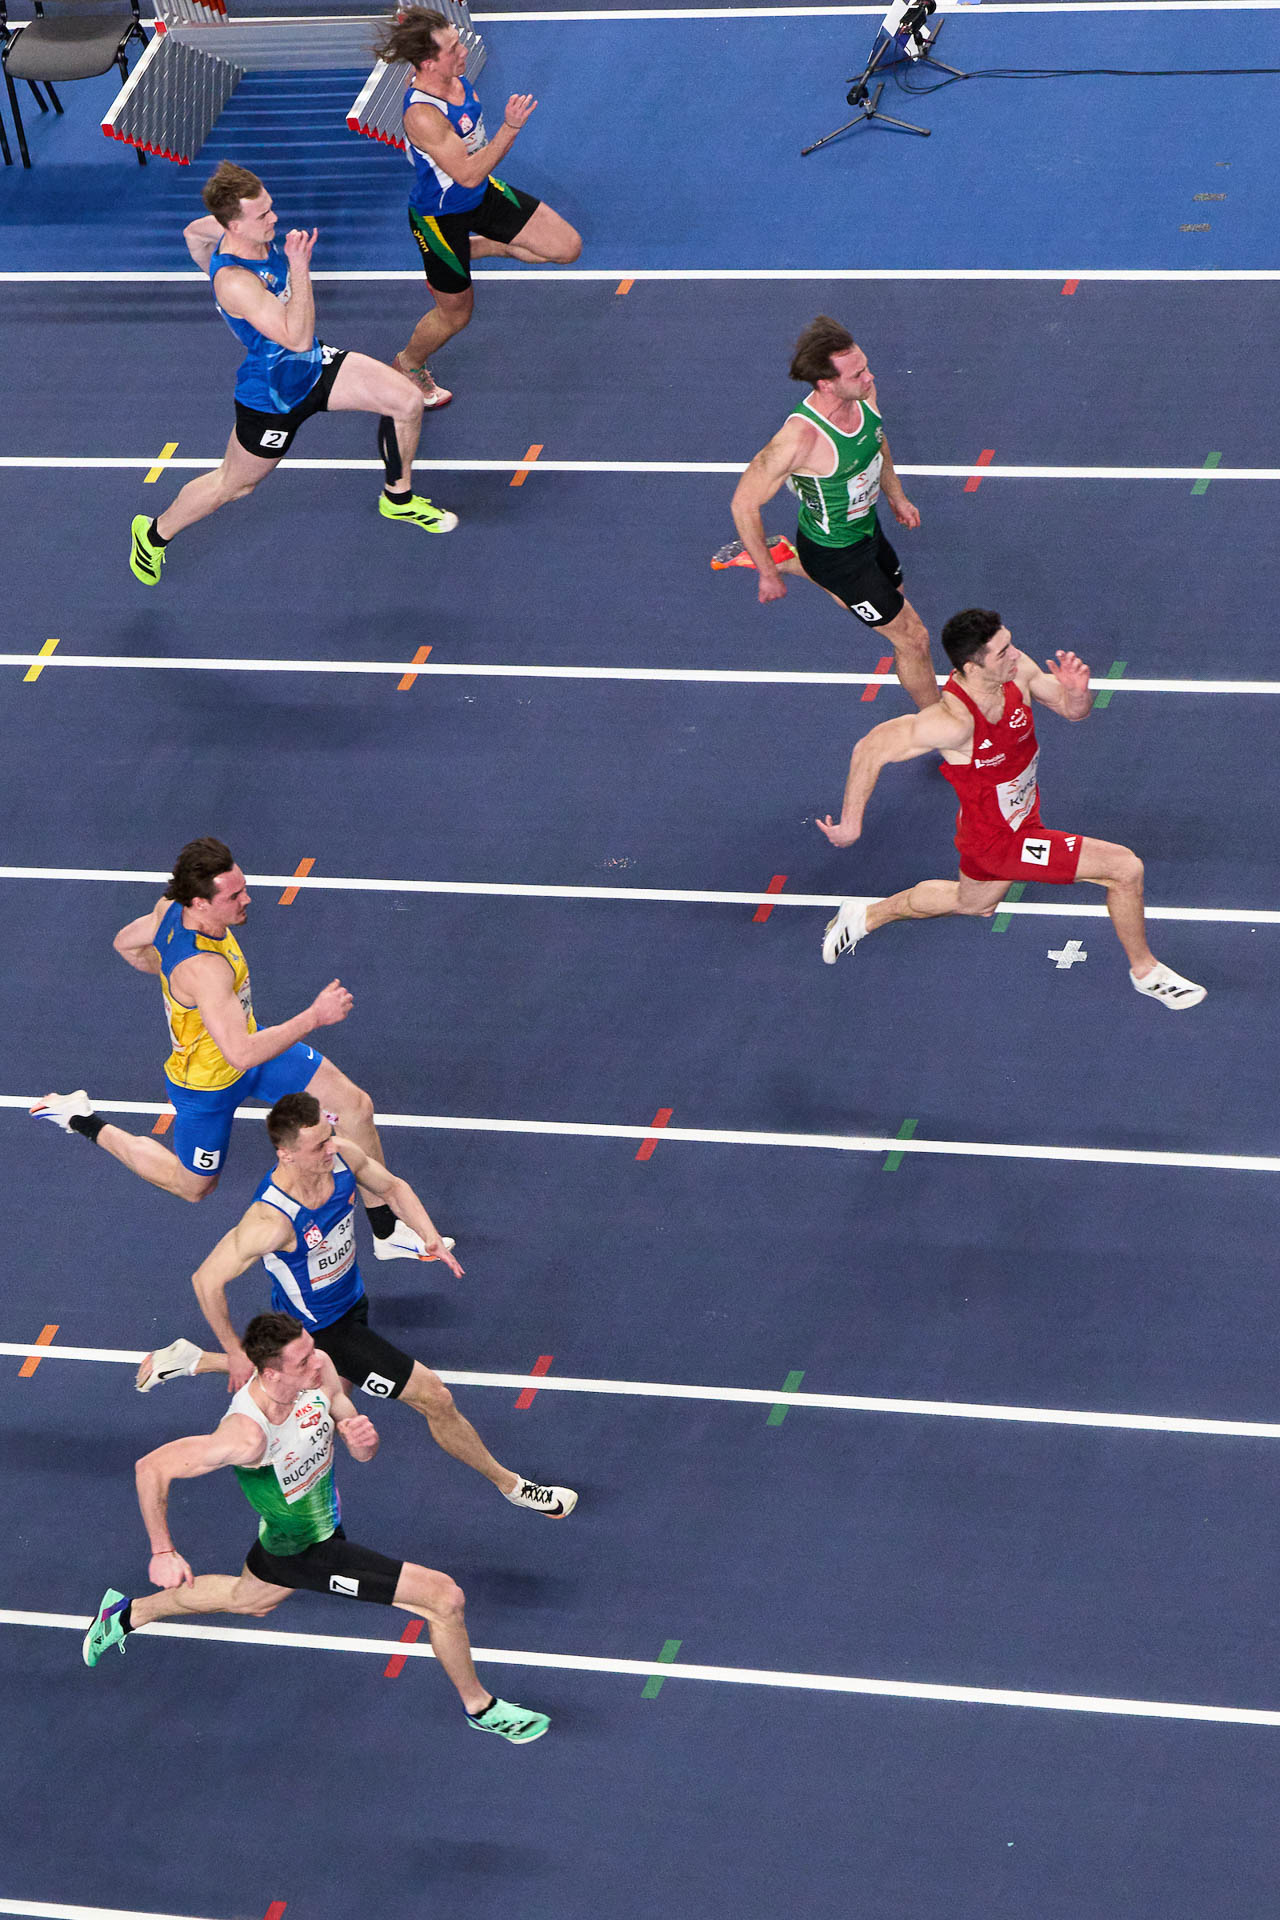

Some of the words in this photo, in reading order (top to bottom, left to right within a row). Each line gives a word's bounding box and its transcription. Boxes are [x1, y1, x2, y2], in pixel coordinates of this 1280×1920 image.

[265, 433, 282, 447] 2
[857, 604, 876, 620] 3
[1025, 844, 1048, 860] 4
[199, 1152, 214, 1169] 5
[366, 1379, 389, 1395] 6
[309, 1421, 330, 1446] 190
[332, 1580, 355, 1593] 7
